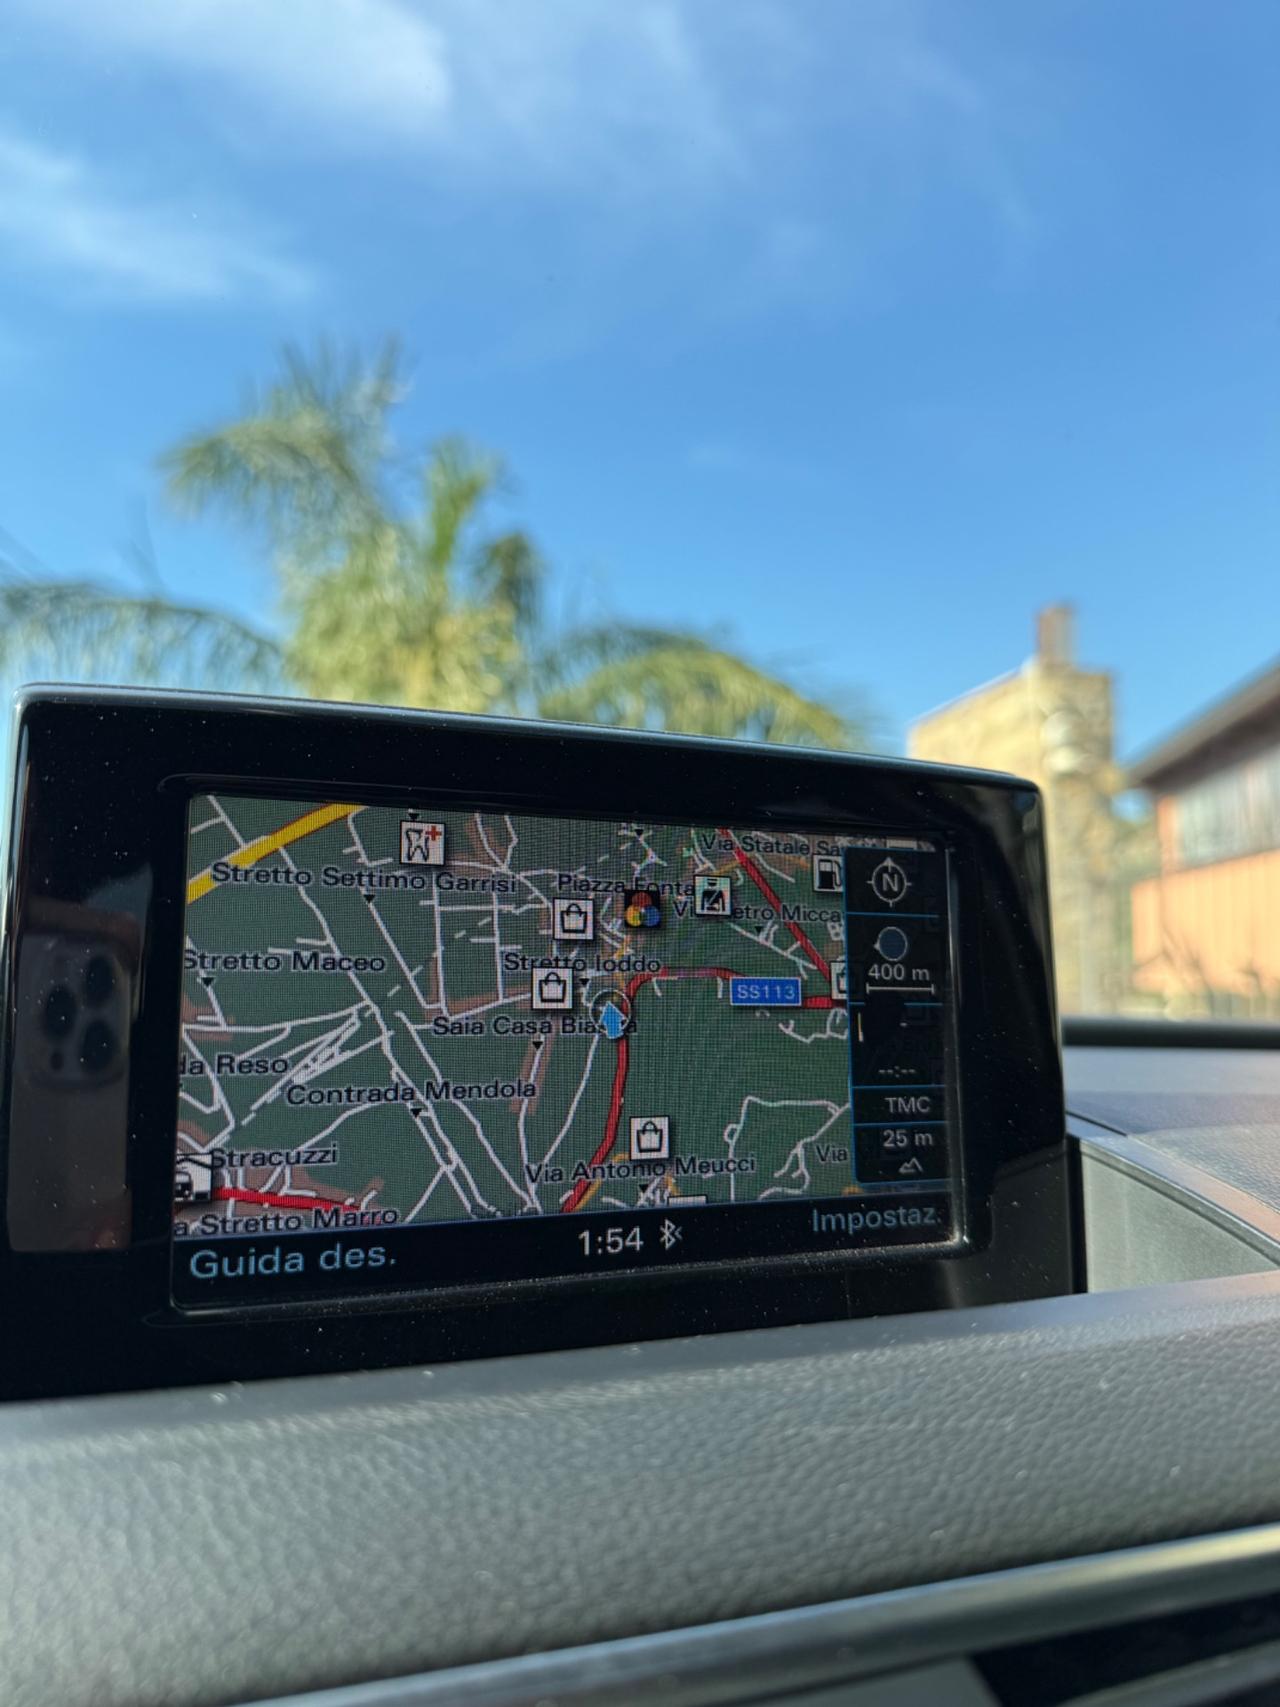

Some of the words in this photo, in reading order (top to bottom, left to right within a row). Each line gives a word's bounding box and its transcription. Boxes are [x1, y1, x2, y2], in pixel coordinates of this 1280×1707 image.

[702, 834, 734, 851] Via
[742, 836, 810, 856] Statale
[212, 860, 312, 884] Stretto
[322, 866, 426, 889] Settimo
[436, 871, 516, 893] Garrisi
[557, 873, 625, 893] Piazza
[781, 903, 842, 923] Micca
[183, 949, 281, 971] Stretto
[292, 951, 386, 972] Maceo
[504, 952, 587, 972] Stretto
[868, 963, 906, 982] 400
[912, 967, 931, 981] m
[736, 984, 796, 1000] SS113
[432, 1015, 485, 1037] Saia
[492, 1015, 553, 1036] Casa
[561, 1016, 638, 1035] Biaa
[216, 1053, 289, 1075] Reso
[287, 1081, 416, 1105] Contrada
[425, 1078, 537, 1101] Mendola
[884, 1095, 932, 1114] TMC
[882, 1129, 908, 1148] 25
[914, 1131, 934, 1146] m
[210, 1142, 338, 1169] Stracuzzi
[815, 1143, 849, 1164] Via
[525, 1163, 564, 1184] Via
[571, 1158, 666, 1182] Antonio
[675, 1153, 756, 1175] Meucci
[201, 1213, 301, 1236] Stretto
[312, 1206, 398, 1229] Marro
[811, 1206, 942, 1235] Impostaz.
[577, 1226, 645, 1257] 1:54
[189, 1245, 306, 1280] Guida
[318, 1242, 397, 1271] des.
